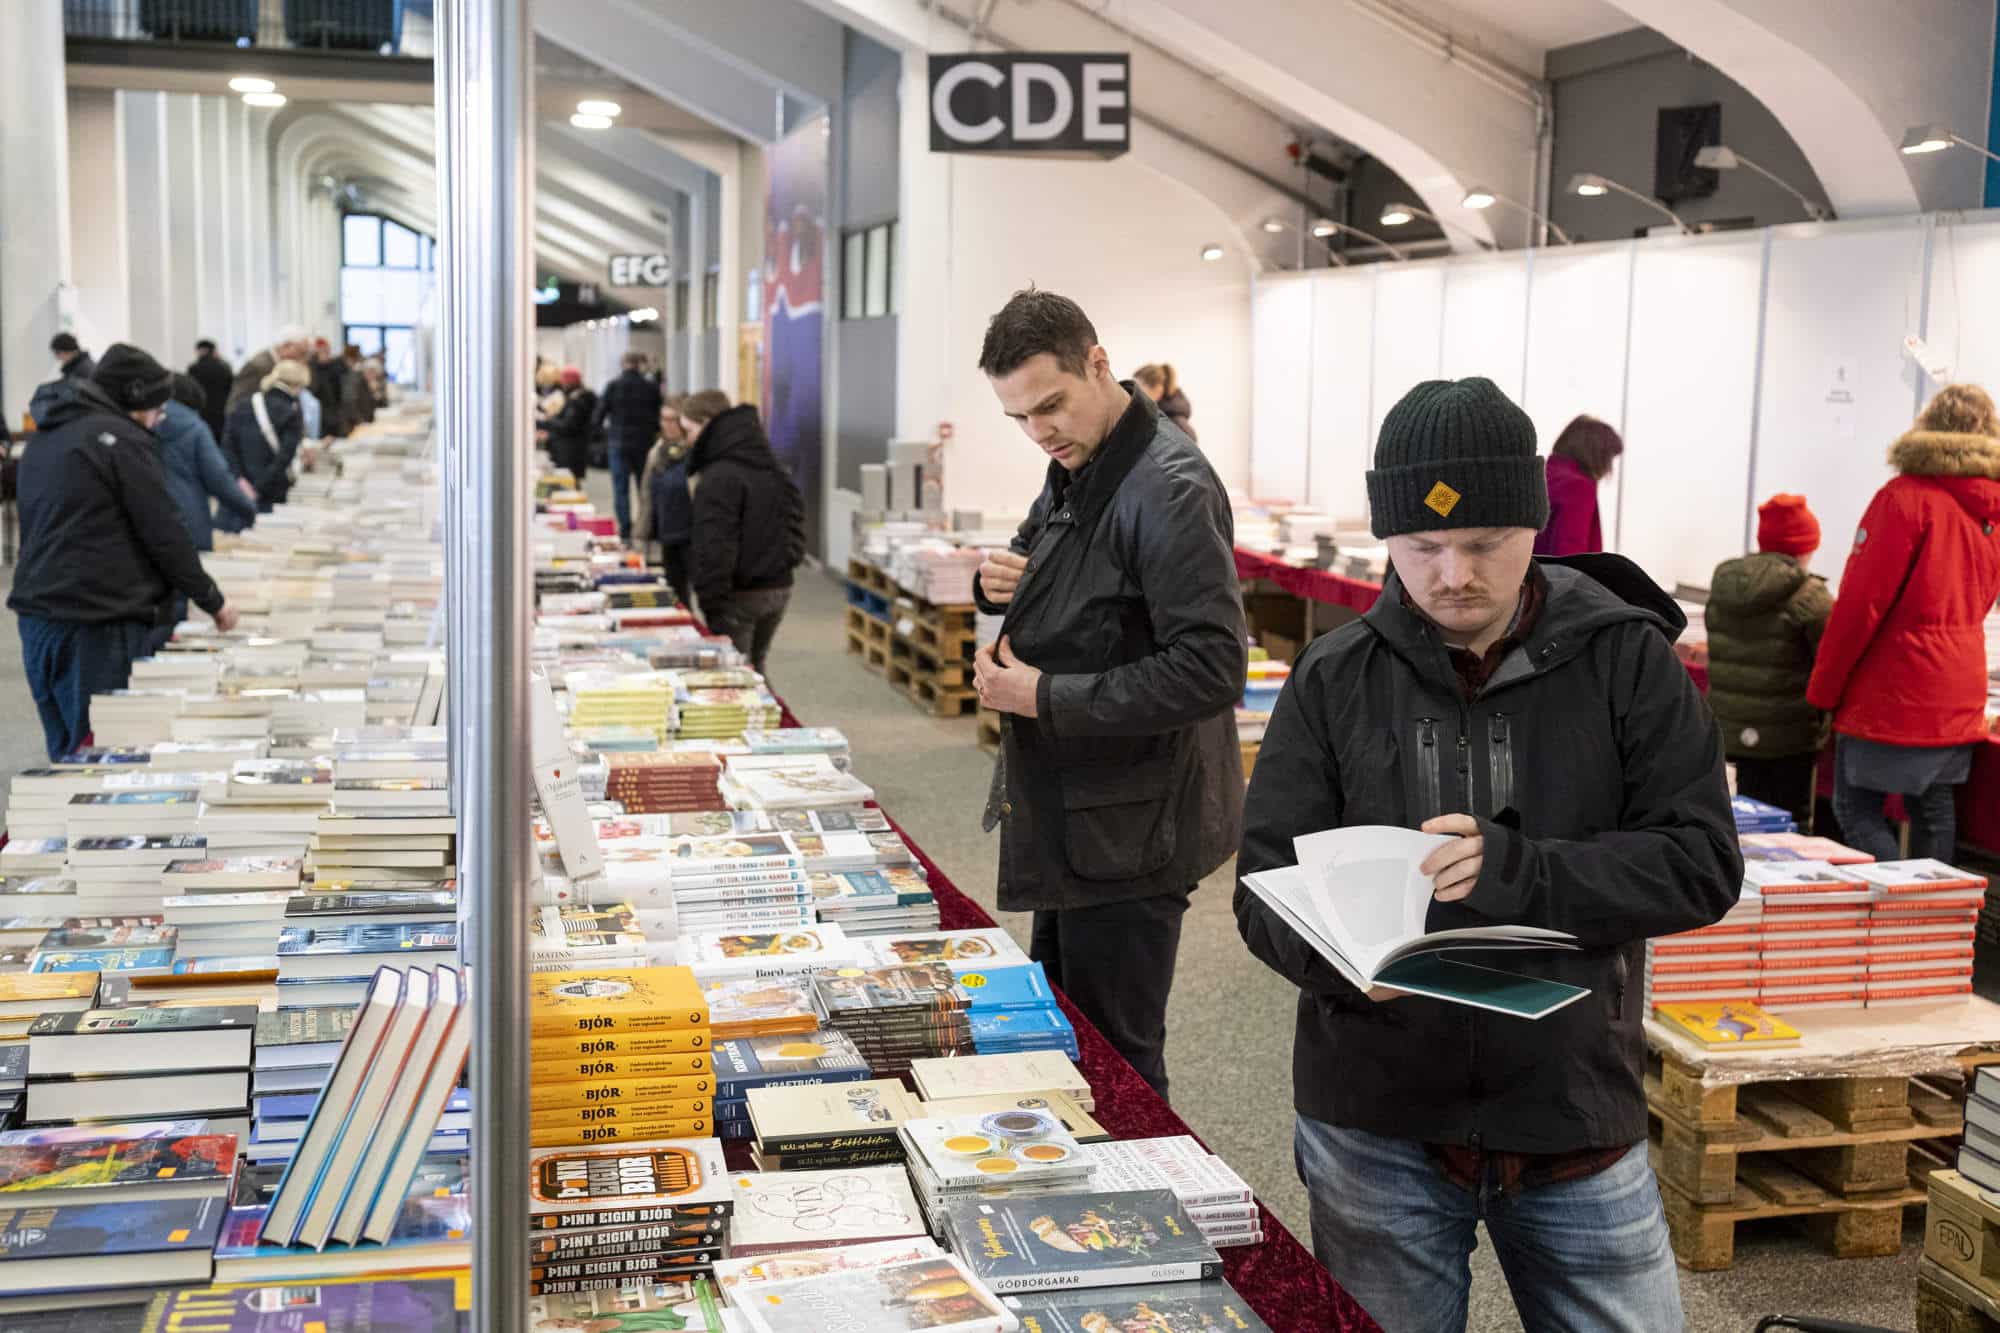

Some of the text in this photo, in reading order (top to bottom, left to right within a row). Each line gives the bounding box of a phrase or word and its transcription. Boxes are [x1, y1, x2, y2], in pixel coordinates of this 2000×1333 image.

[933, 62, 1126, 142] CDE
[611, 255, 671, 286] EFG
[578, 1015, 615, 1031] BJÓR
[580, 1039, 616, 1055] BJÓR
[580, 1060, 615, 1076] BJÓR
[586, 1084, 621, 1101] BJÓR
[582, 1104, 617, 1121] BJÓR
[583, 1125, 617, 1141] BJÓR
[599, 1210, 635, 1224] EIGIN
[597, 1230, 634, 1244] EIGIN
[1940, 1225, 1969, 1258] EPAL
[585, 1260, 621, 1275] EIGIN
